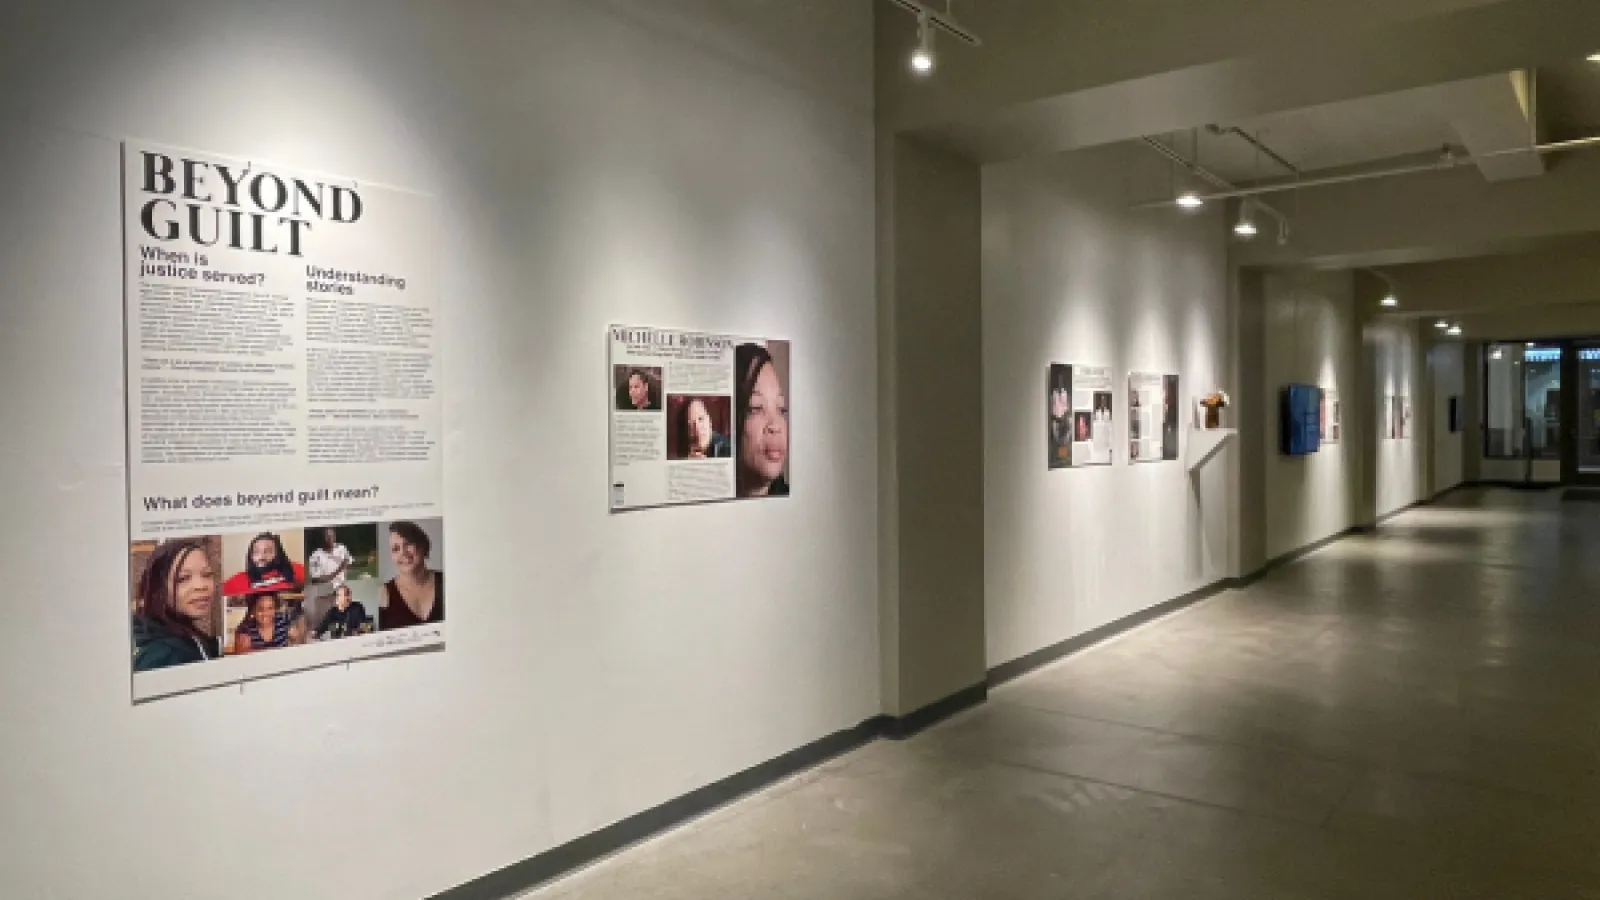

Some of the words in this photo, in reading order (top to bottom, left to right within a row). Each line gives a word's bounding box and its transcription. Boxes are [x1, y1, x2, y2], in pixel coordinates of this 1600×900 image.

[140, 150, 363, 223] BEYOND
[140, 198, 312, 257] GUILT
[140, 246, 190, 263] When
[194, 251, 209, 266] is
[139, 263, 198, 280] justice
[202, 270, 265, 287] served?
[306, 264, 406, 290] Understanding
[306, 281, 354, 296] stories
[143, 496, 188, 512] What
[191, 494, 233, 510] does
[236, 490, 294, 508] beyond
[298, 488, 329, 506] guilt
[332, 485, 380, 501] mean?
